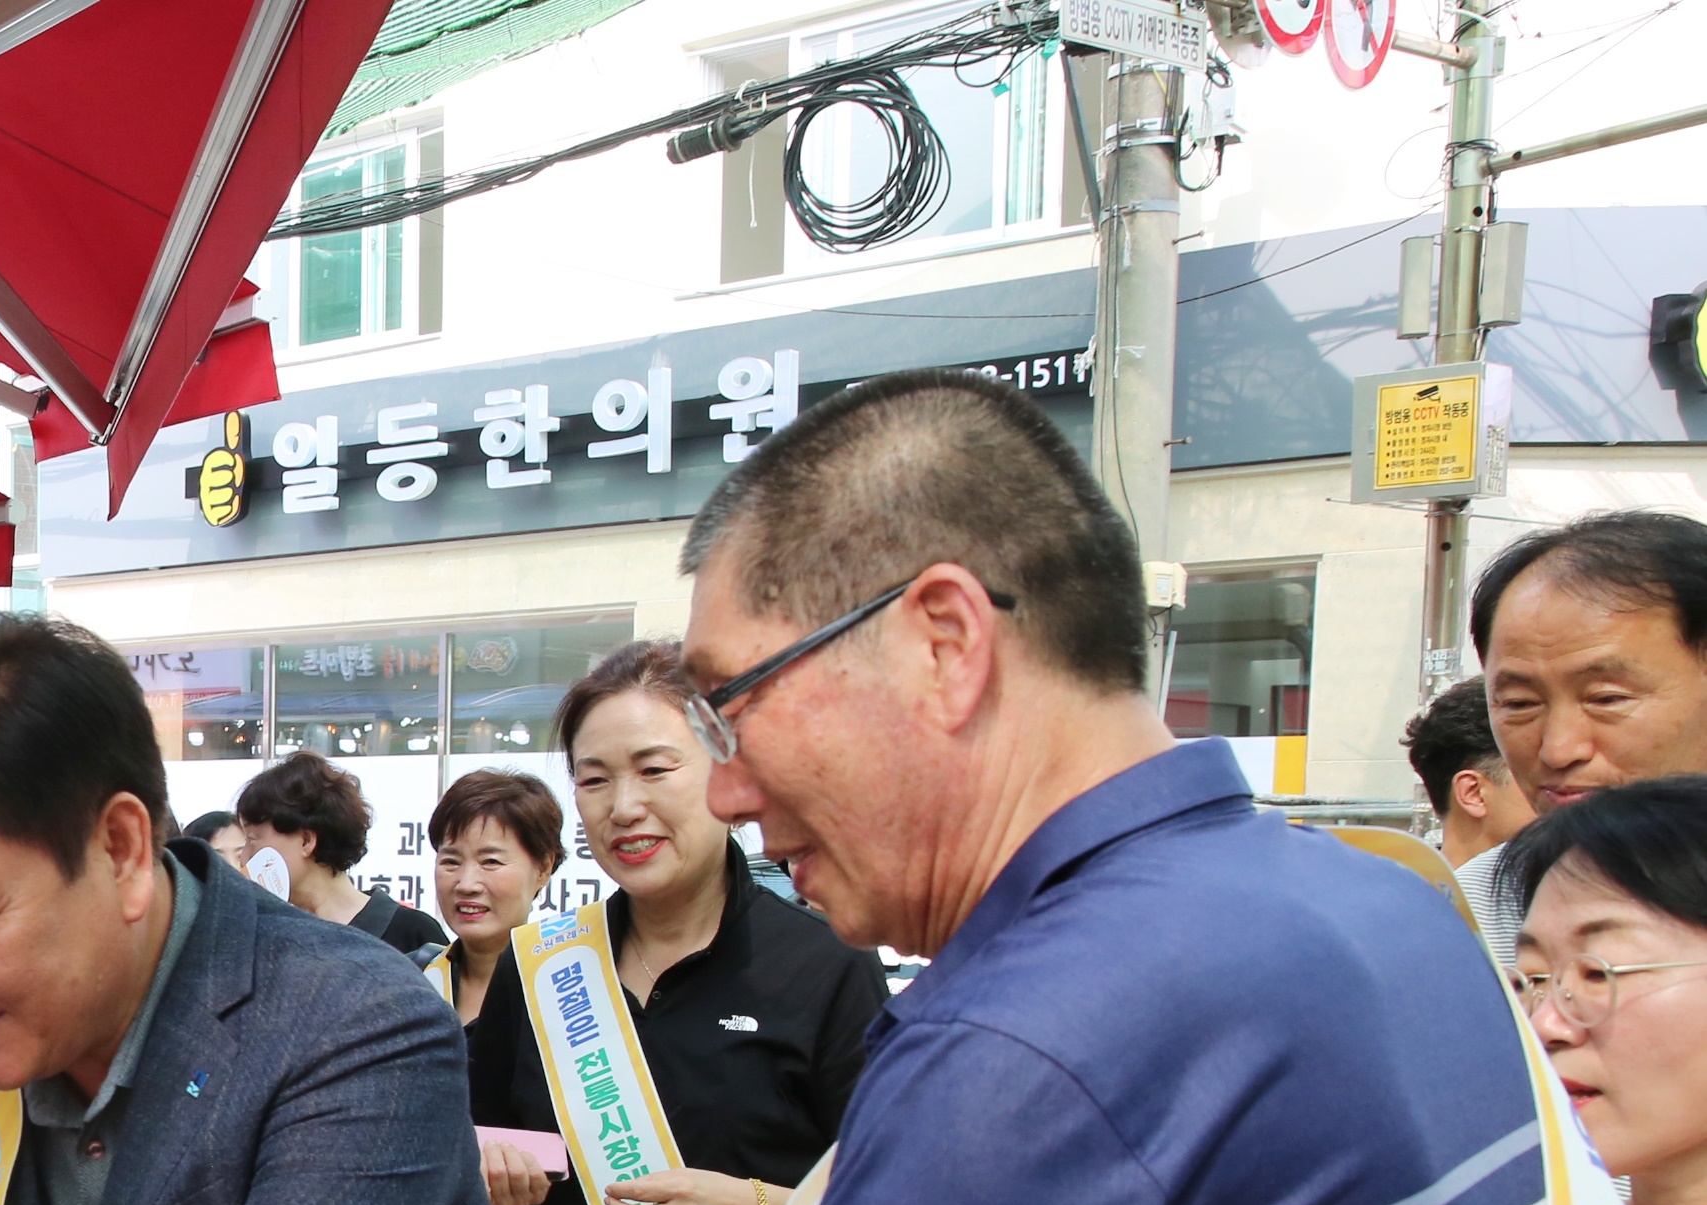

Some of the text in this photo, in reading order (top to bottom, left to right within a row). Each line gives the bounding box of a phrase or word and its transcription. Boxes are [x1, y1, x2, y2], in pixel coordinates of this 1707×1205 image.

[1070, 0, 1200, 62] 방범용 CCTV 카메라 작동중
[273, 349, 800, 514] 일등한의원
[1413, 405, 1440, 421] CCTV
[1443, 401, 1469, 418] 작동중
[532, 925, 590, 954] 수원특례시
[551, 962, 602, 1048] 명절은
[574, 1048, 653, 1190] 전통시장
